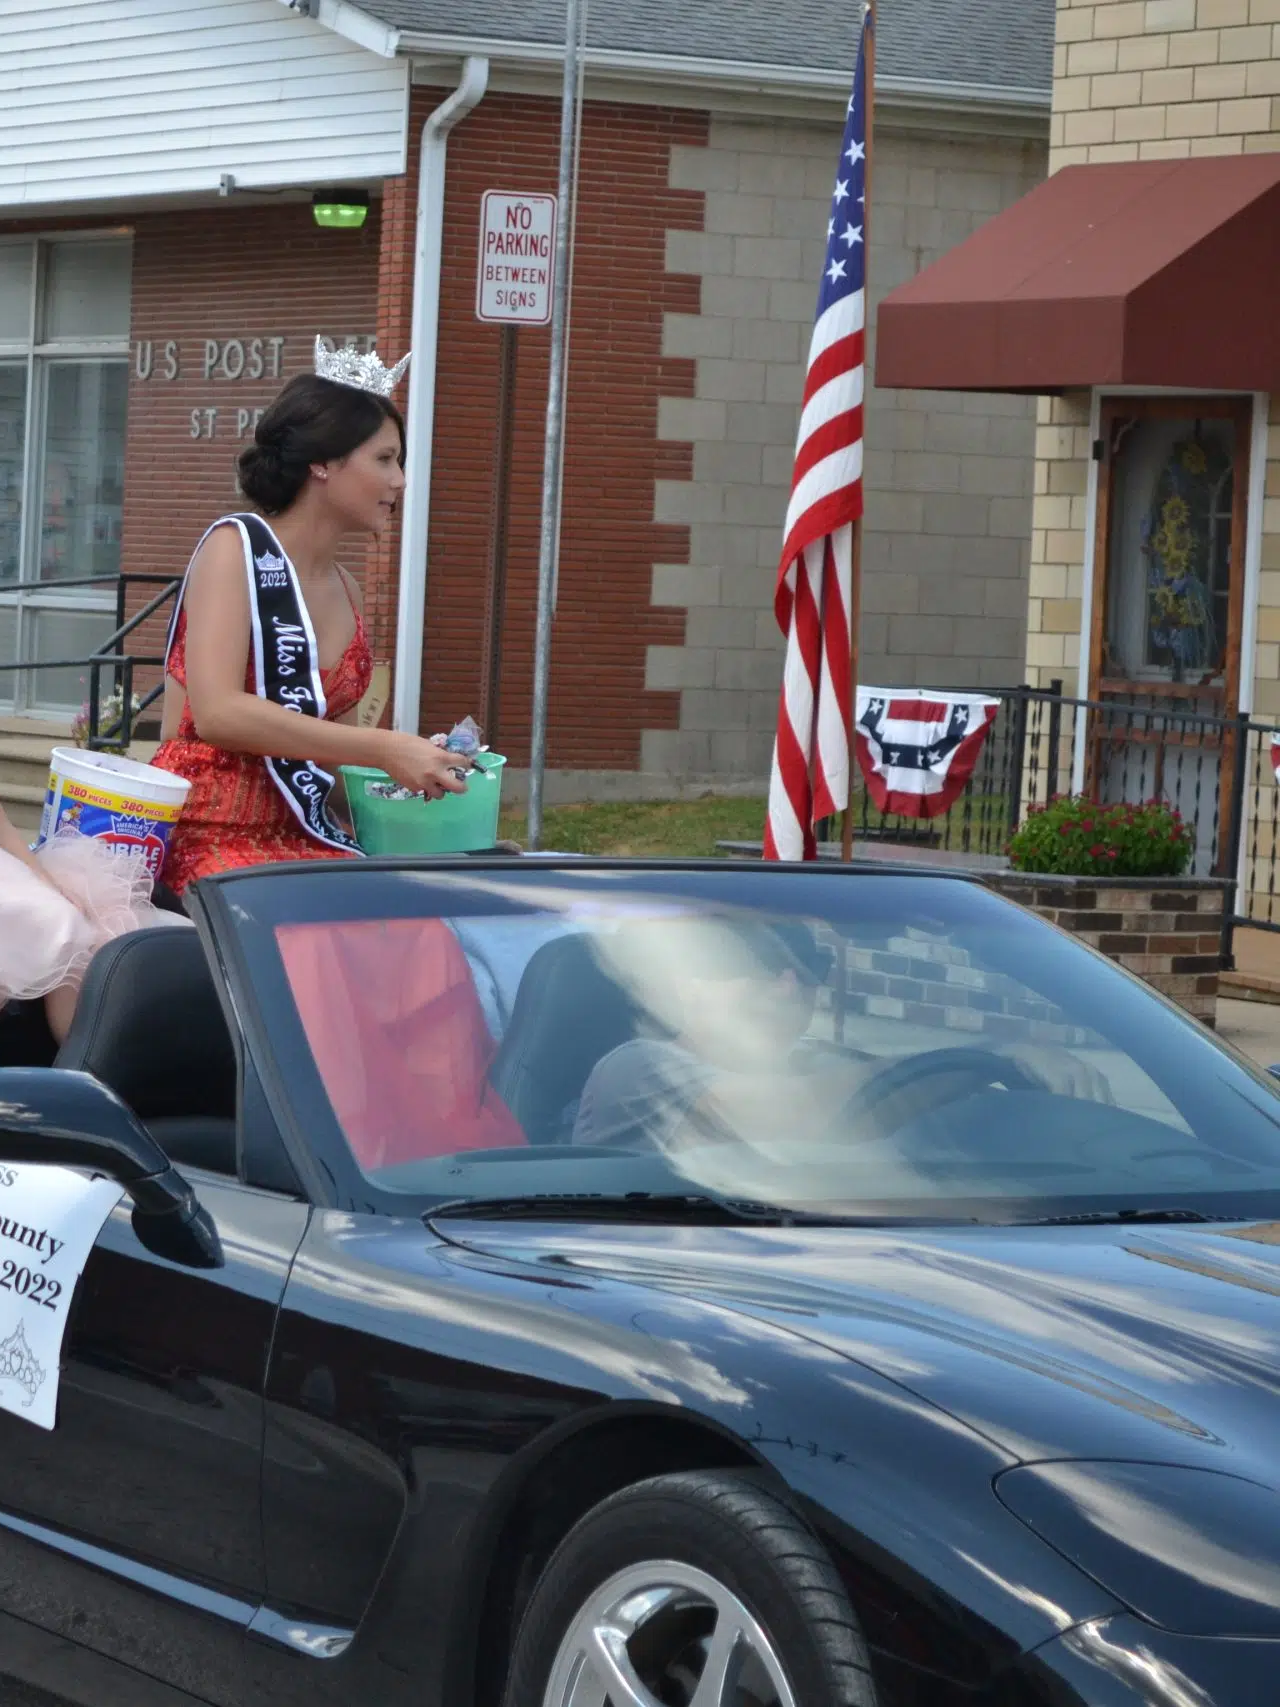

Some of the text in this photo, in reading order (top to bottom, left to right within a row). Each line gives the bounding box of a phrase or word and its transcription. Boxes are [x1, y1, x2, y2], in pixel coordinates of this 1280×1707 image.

[506, 205, 532, 230] NO
[486, 231, 549, 258] PARKING
[485, 264, 547, 285] BETWEEN
[495, 289, 536, 308] SIGNS
[135, 340, 153, 379] U
[164, 339, 180, 380] S
[204, 336, 284, 380] POST
[190, 407, 217, 439] ST
[260, 572, 288, 588] 2022
[272, 616, 307, 676] Miss
[67, 784, 87, 798] 380
[88, 793, 112, 807] PIECES
[120, 800, 143, 813] 380
[144, 809, 165, 818] PIECES
[116, 821, 150, 833] AMERICA'S
[117, 828, 144, 837] ORIGINAL
